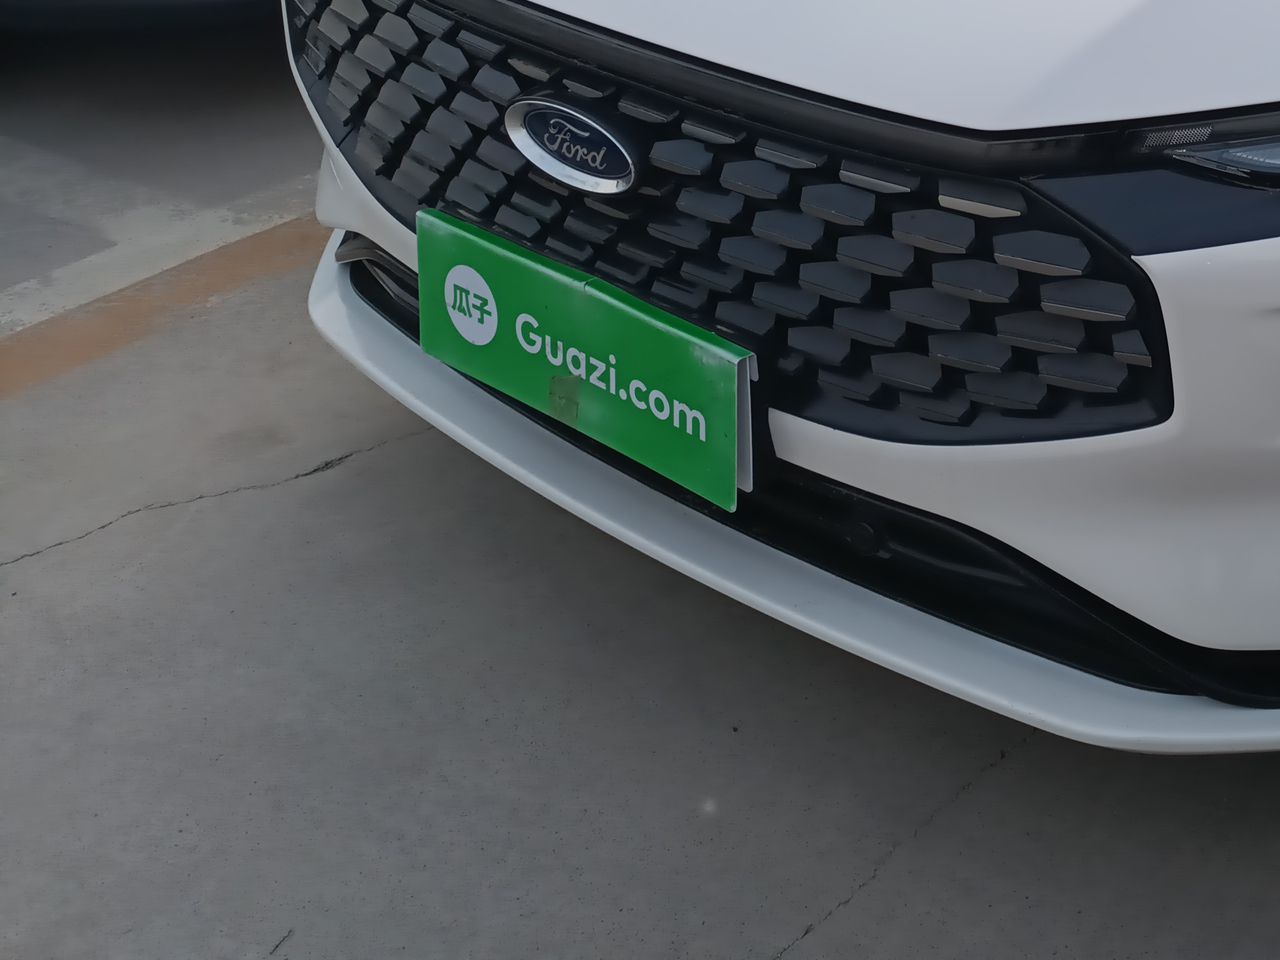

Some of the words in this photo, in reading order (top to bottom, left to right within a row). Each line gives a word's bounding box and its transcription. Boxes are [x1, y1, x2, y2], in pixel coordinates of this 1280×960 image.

[543, 117, 608, 171] Ford
[450, 283, 493, 326] 瓜子
[514, 311, 708, 443] Guazi.com
